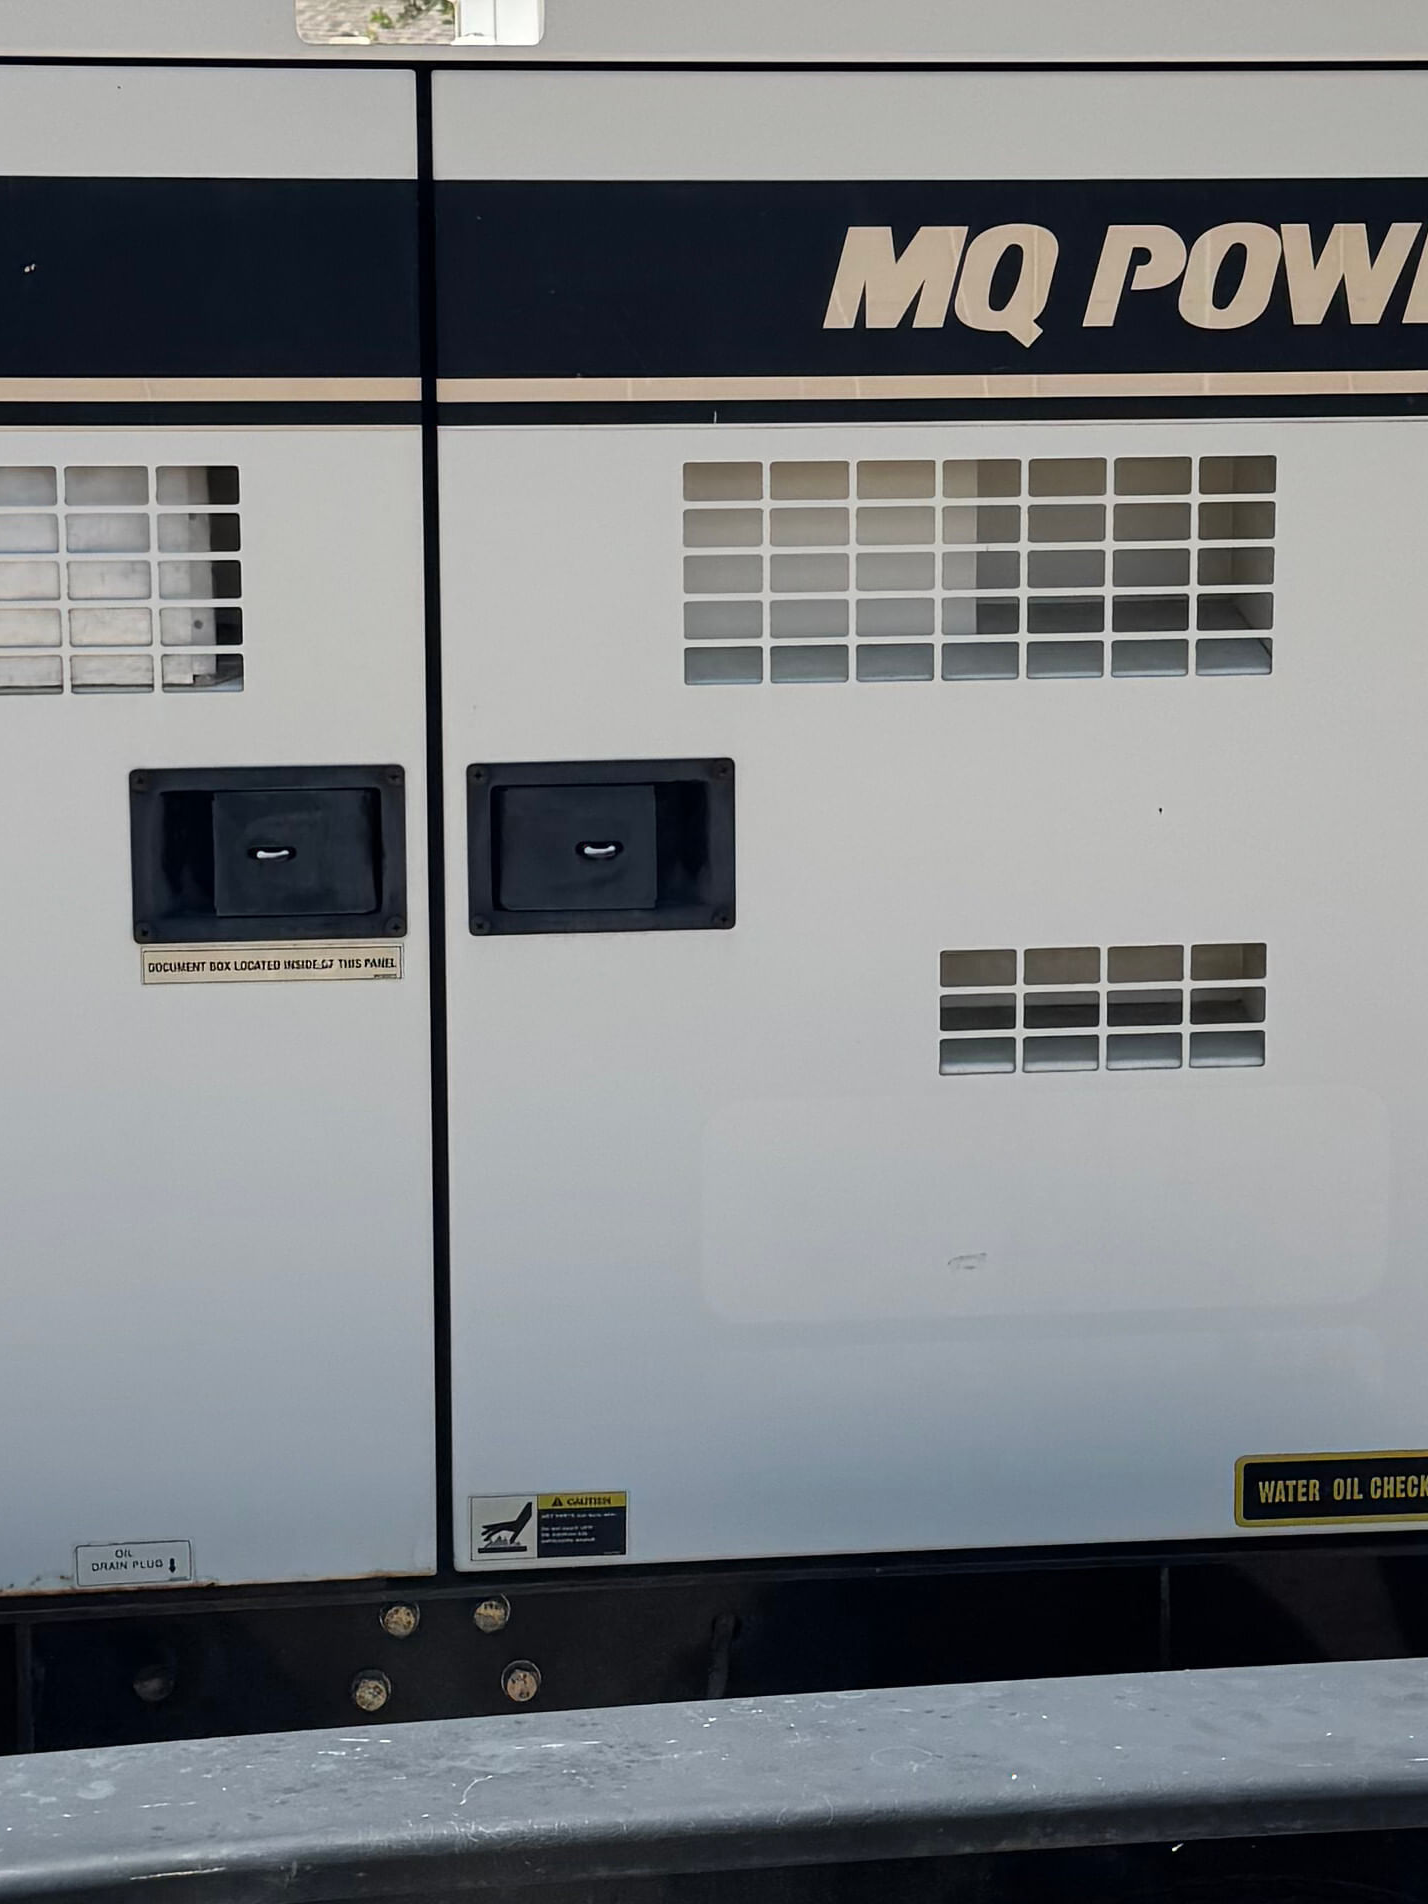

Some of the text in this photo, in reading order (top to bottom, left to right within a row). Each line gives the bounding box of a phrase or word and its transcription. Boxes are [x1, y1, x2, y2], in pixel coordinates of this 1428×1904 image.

[822, 223, 1060, 348] MQ
[148, 961, 206, 972] DOCUMENT
[210, 960, 231, 971] BOX
[234, 960, 280, 971] LOCATED
[338, 958, 362, 968] THIS
[1258, 1478, 1320, 1504] WATER
[1332, 1476, 1363, 1501] OIL
[115, 1549, 133, 1558] OIL
[92, 1559, 163, 1571] DRAIN PLUG
